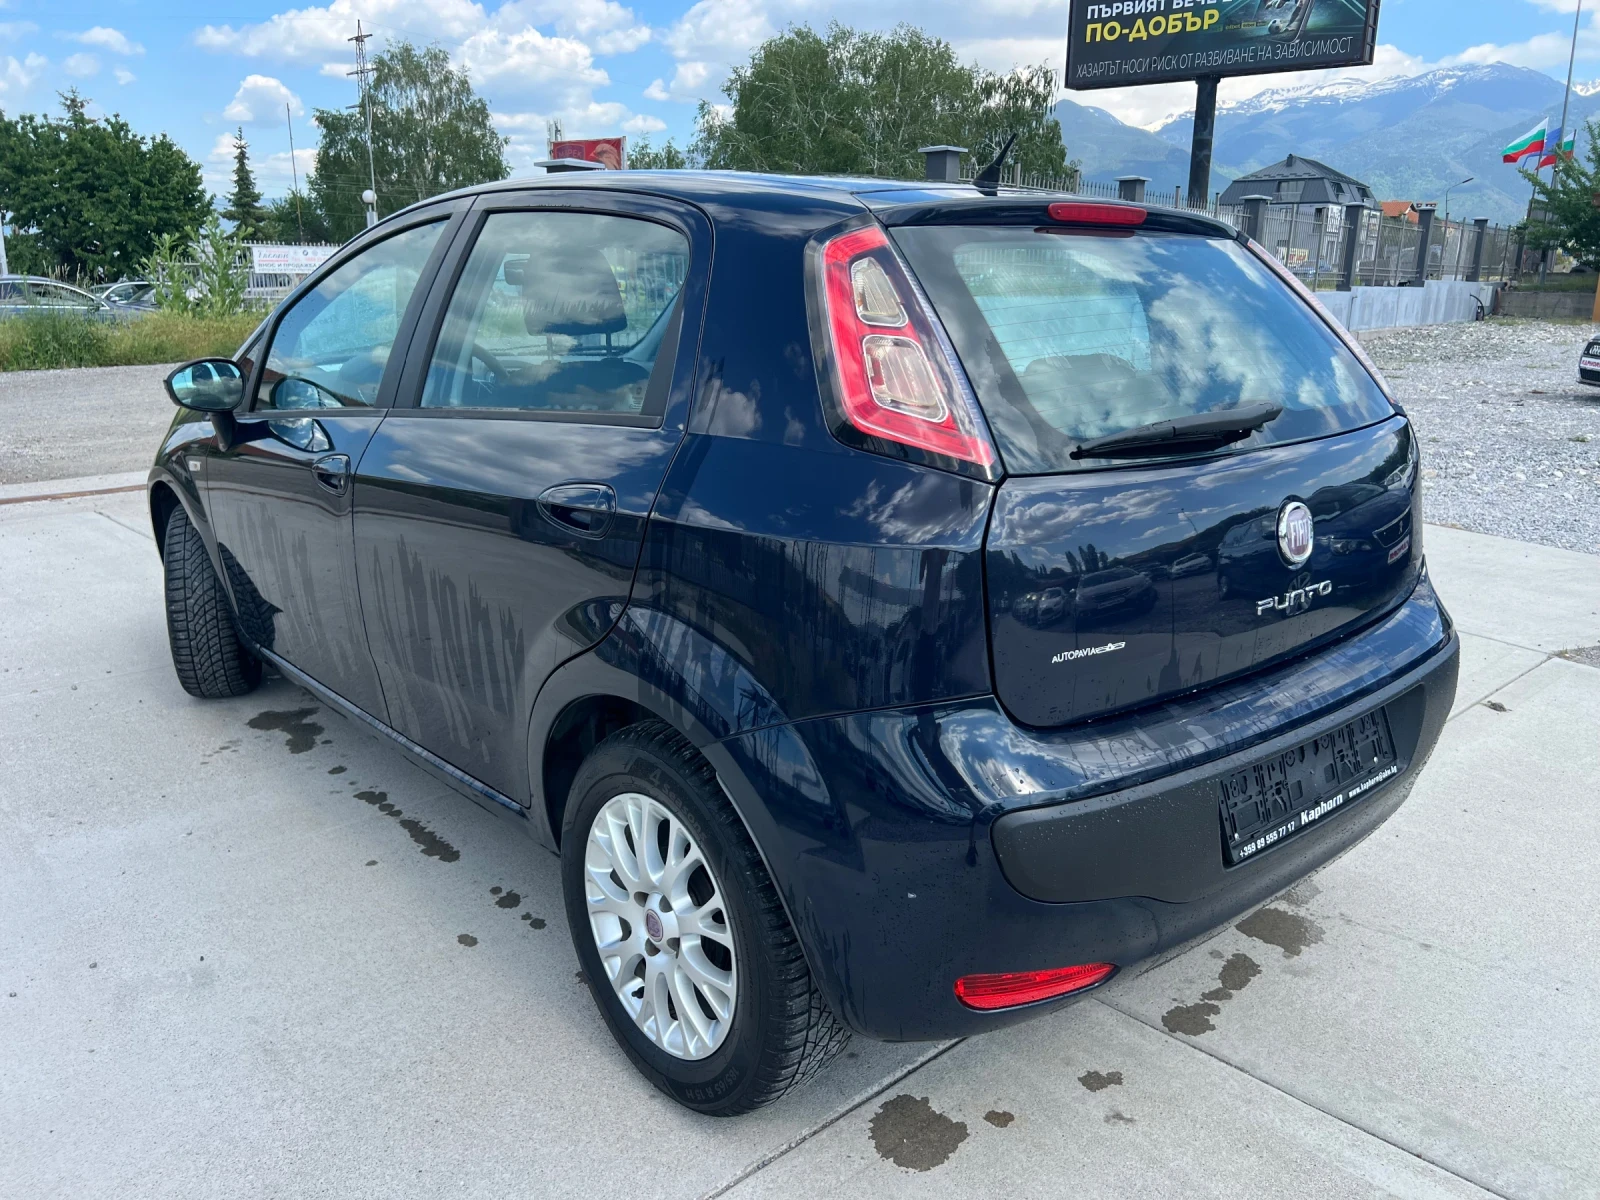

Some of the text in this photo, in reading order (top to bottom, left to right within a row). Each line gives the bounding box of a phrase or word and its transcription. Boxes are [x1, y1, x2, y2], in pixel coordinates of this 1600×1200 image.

[1085, 9, 1219, 43] ПО-ДОБЪР
[1087, 0, 1165, 19] ПЪРВИЯТ
[1076, 36, 1353, 78] ХАЗАРТЪТ НОСИ РИСК ОТ РАЗВИВАНЕ НА ЗАВИСИМОСТ
[1289, 517, 1311, 549] FIAT
[1256, 580, 1333, 616] PUNTO
[1051, 647, 1096, 664] AUTOPAVIA
[1240, 842, 1256, 858] +359
[1256, 837, 1265, 849] 89
[1265, 830, 1278, 844] 555
[1278, 825, 1286, 837] 77
[1287, 821, 1295, 832] 17
[1300, 794, 1343, 825] Kaphorn
